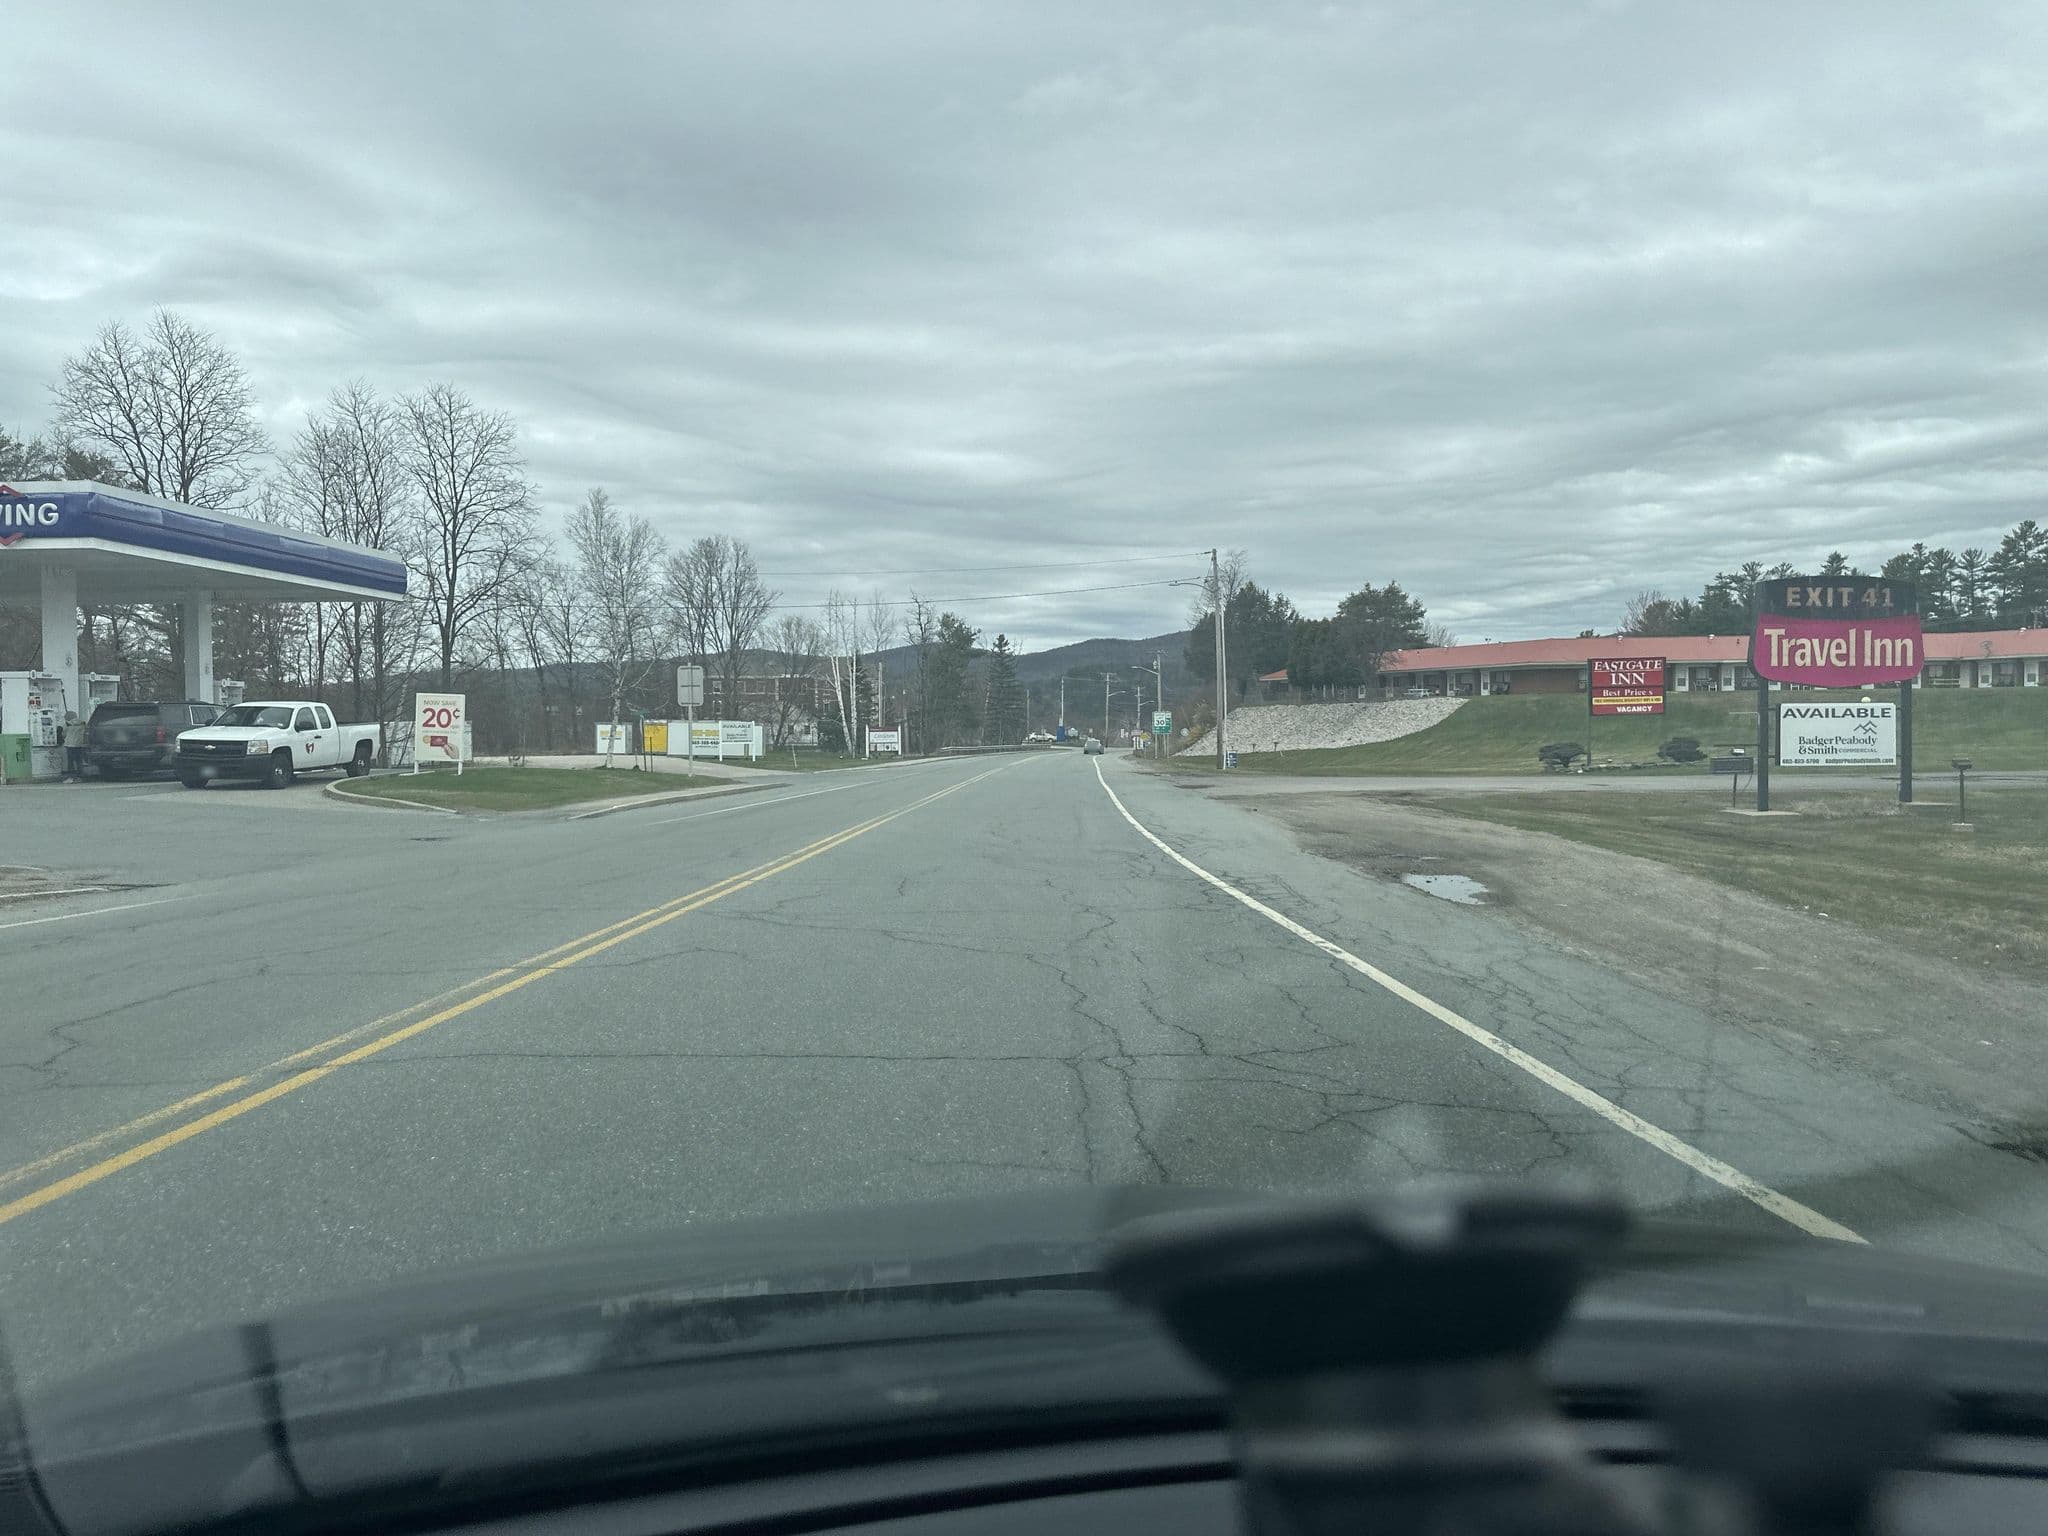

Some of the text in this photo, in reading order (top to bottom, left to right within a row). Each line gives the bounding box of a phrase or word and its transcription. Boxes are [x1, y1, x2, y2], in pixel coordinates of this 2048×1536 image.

[1786, 586, 1894, 608] EXIT 41
[1763, 628, 1914, 667] Travel Inn
[1594, 660, 1662, 672] EASTGATE
[1611, 672, 1645, 685] INN
[1603, 689, 1620, 697] Best
[1616, 705, 1653, 713] VACANCY
[1782, 707, 1892, 719] AVAILABLE
[1798, 735, 1877, 747] Badger Peabody
